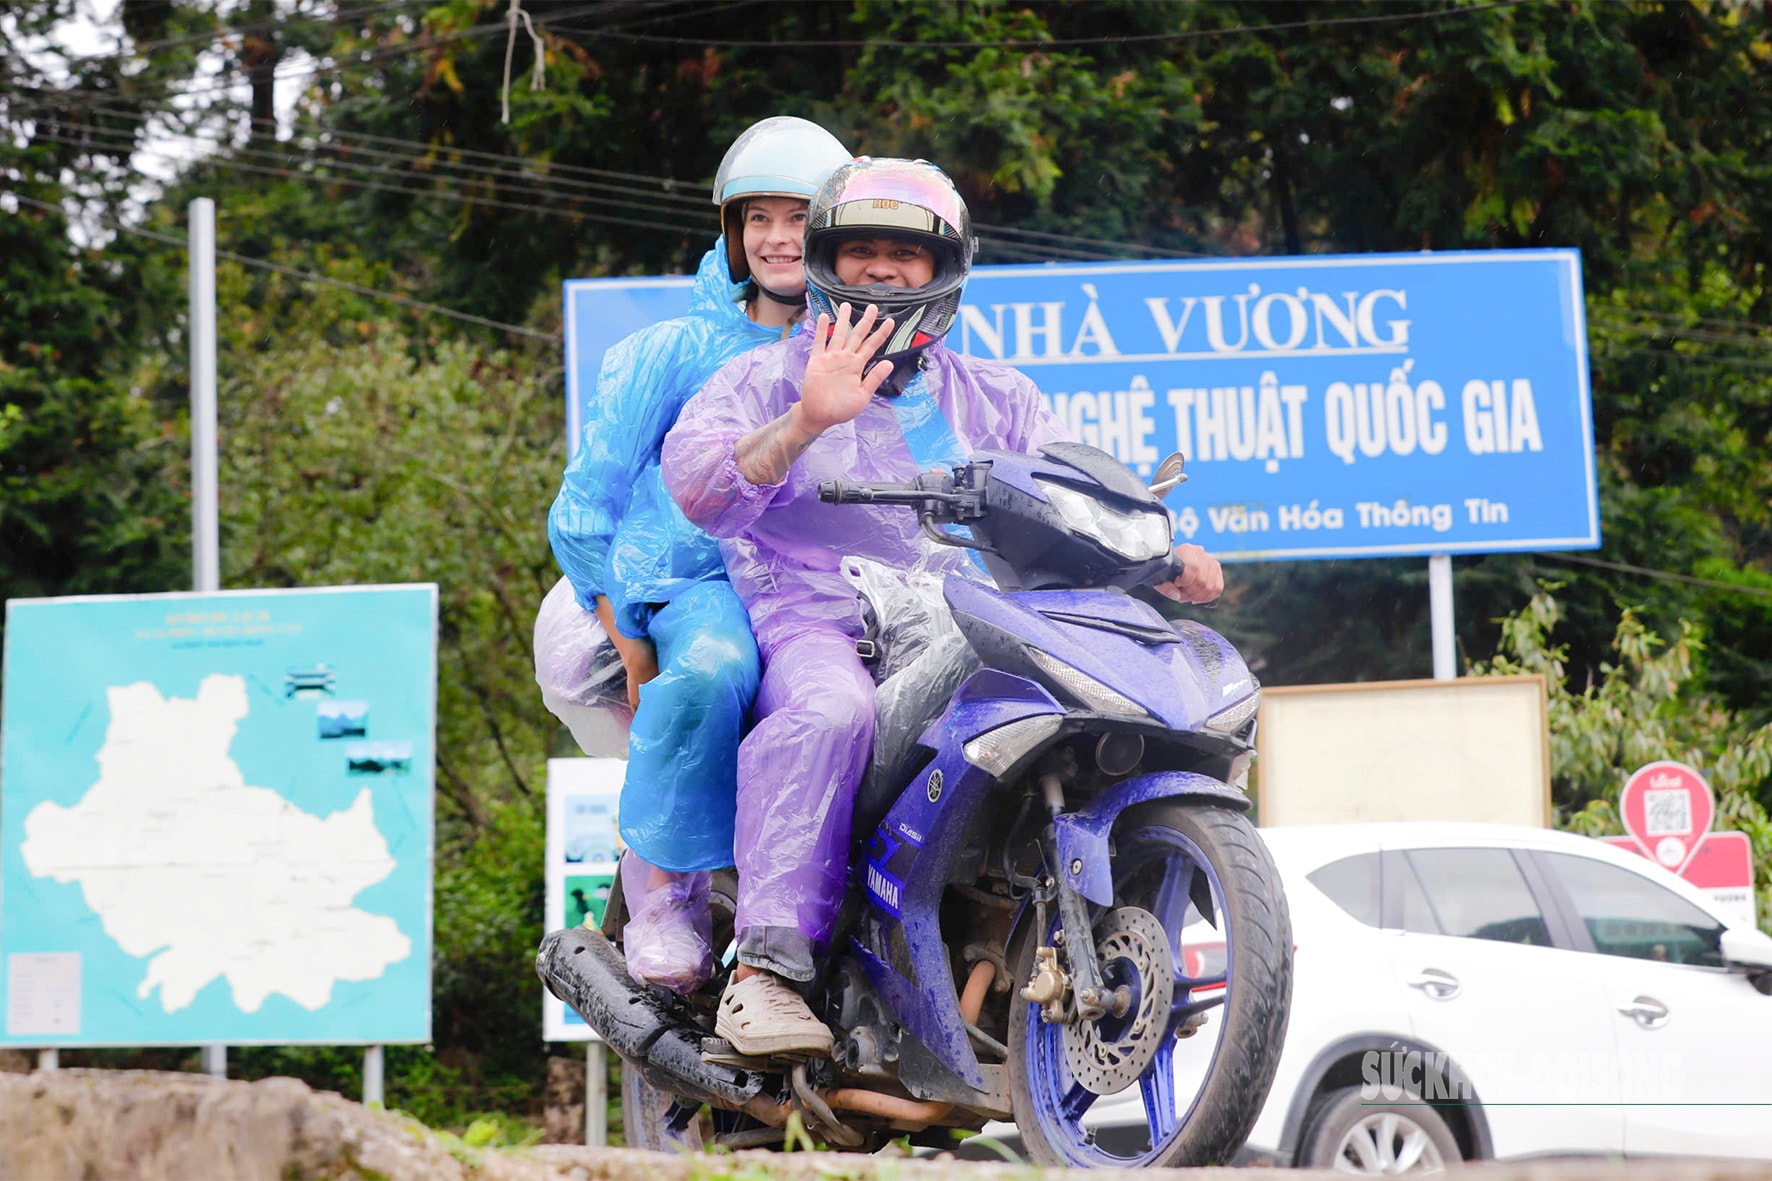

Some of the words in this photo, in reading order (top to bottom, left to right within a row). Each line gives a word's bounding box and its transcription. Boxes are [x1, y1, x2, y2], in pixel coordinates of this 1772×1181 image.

[959, 282, 1121, 360] NHÀ
[1145, 283, 1411, 352] VƯƠNG
[1168, 371, 1307, 473] THUẬT
[1325, 358, 1447, 464] QUỐC
[1462, 379, 1542, 454] GIA
[1279, 500, 1344, 530] Hóa
[1356, 499, 1453, 532] Thông
[868, 864, 898, 908] YAMAHA
